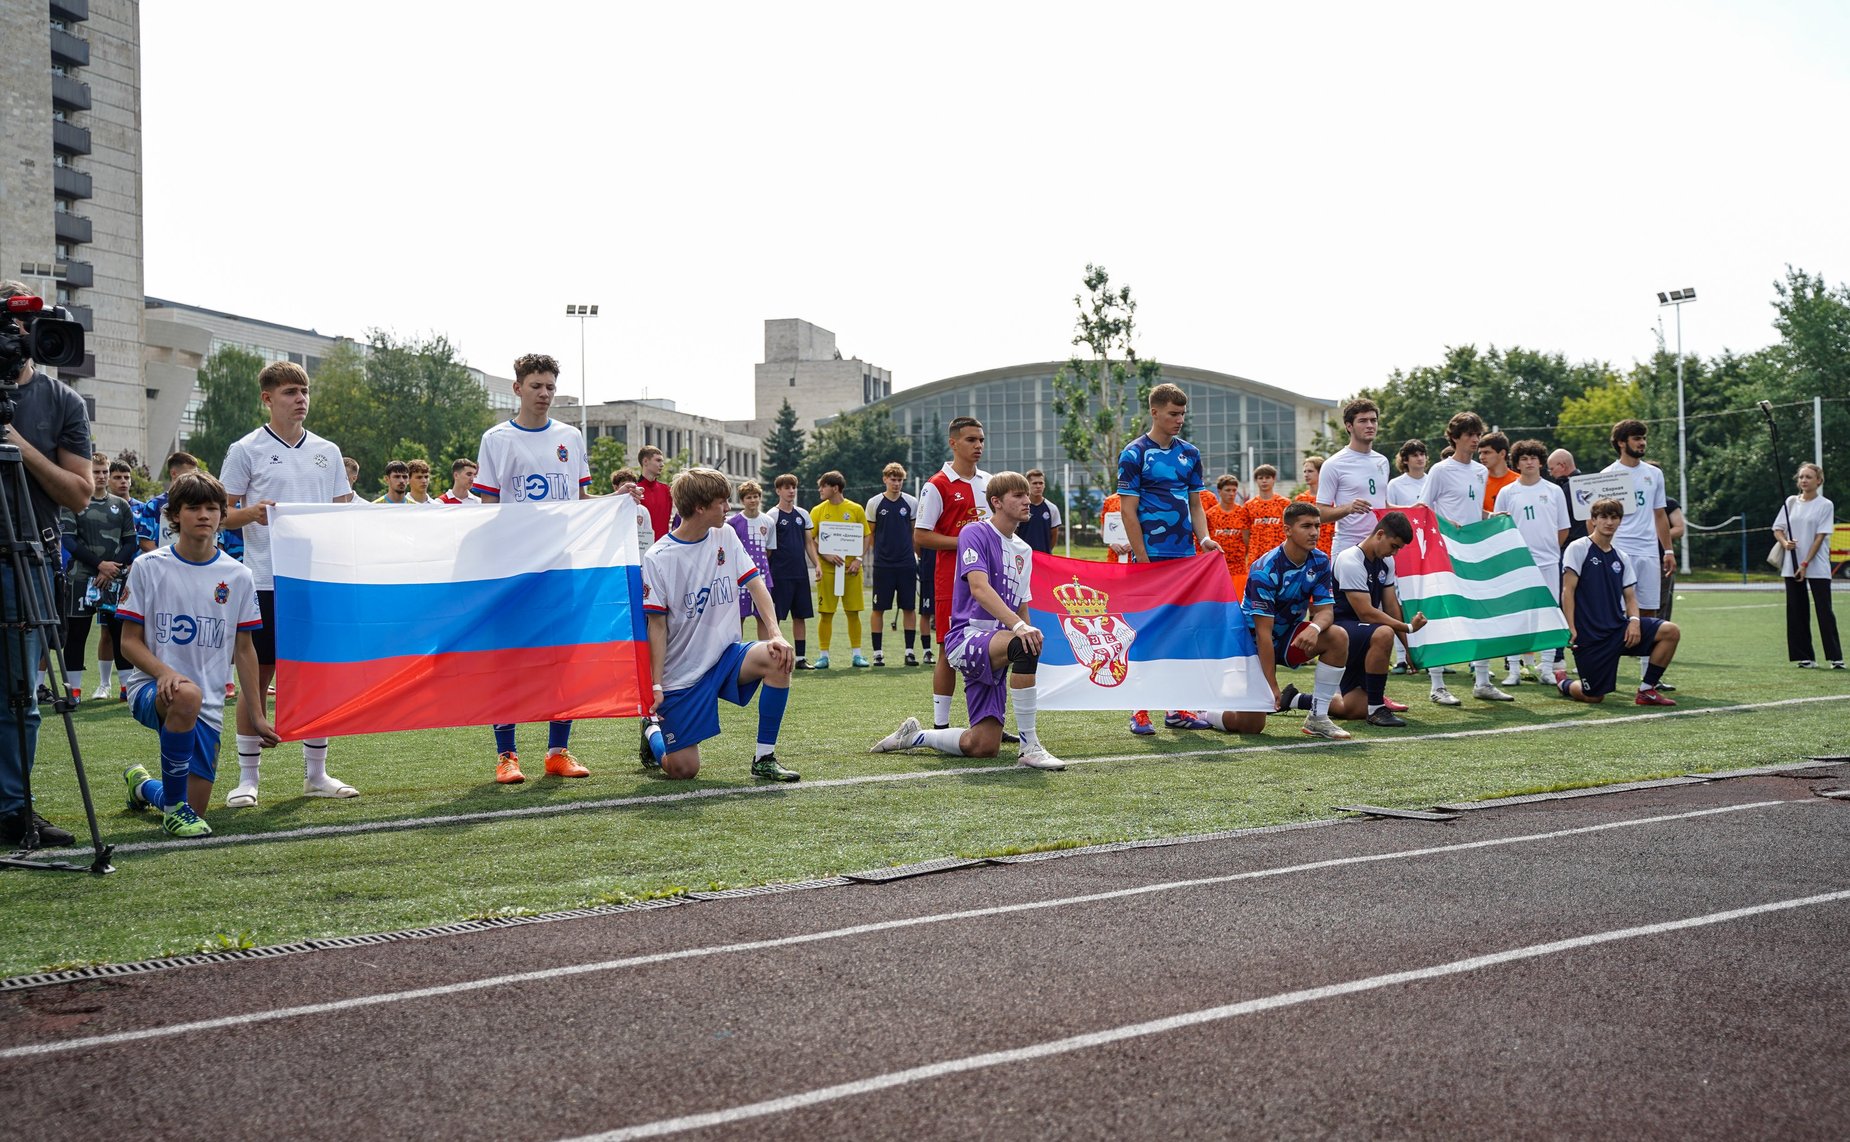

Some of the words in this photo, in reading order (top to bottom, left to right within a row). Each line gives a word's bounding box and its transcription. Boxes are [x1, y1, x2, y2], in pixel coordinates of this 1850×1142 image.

[511, 472, 571, 503] УЭТМ
[1368, 478, 1376, 495] 8
[1468, 484, 1475, 501] 4
[1601, 485, 1624, 493] Сборная
[1523, 505, 1535, 520] 11
[155, 612, 226, 649] УЭТМ
[1581, 678, 1591, 691] 5
[665, 732, 677, 745] 2
